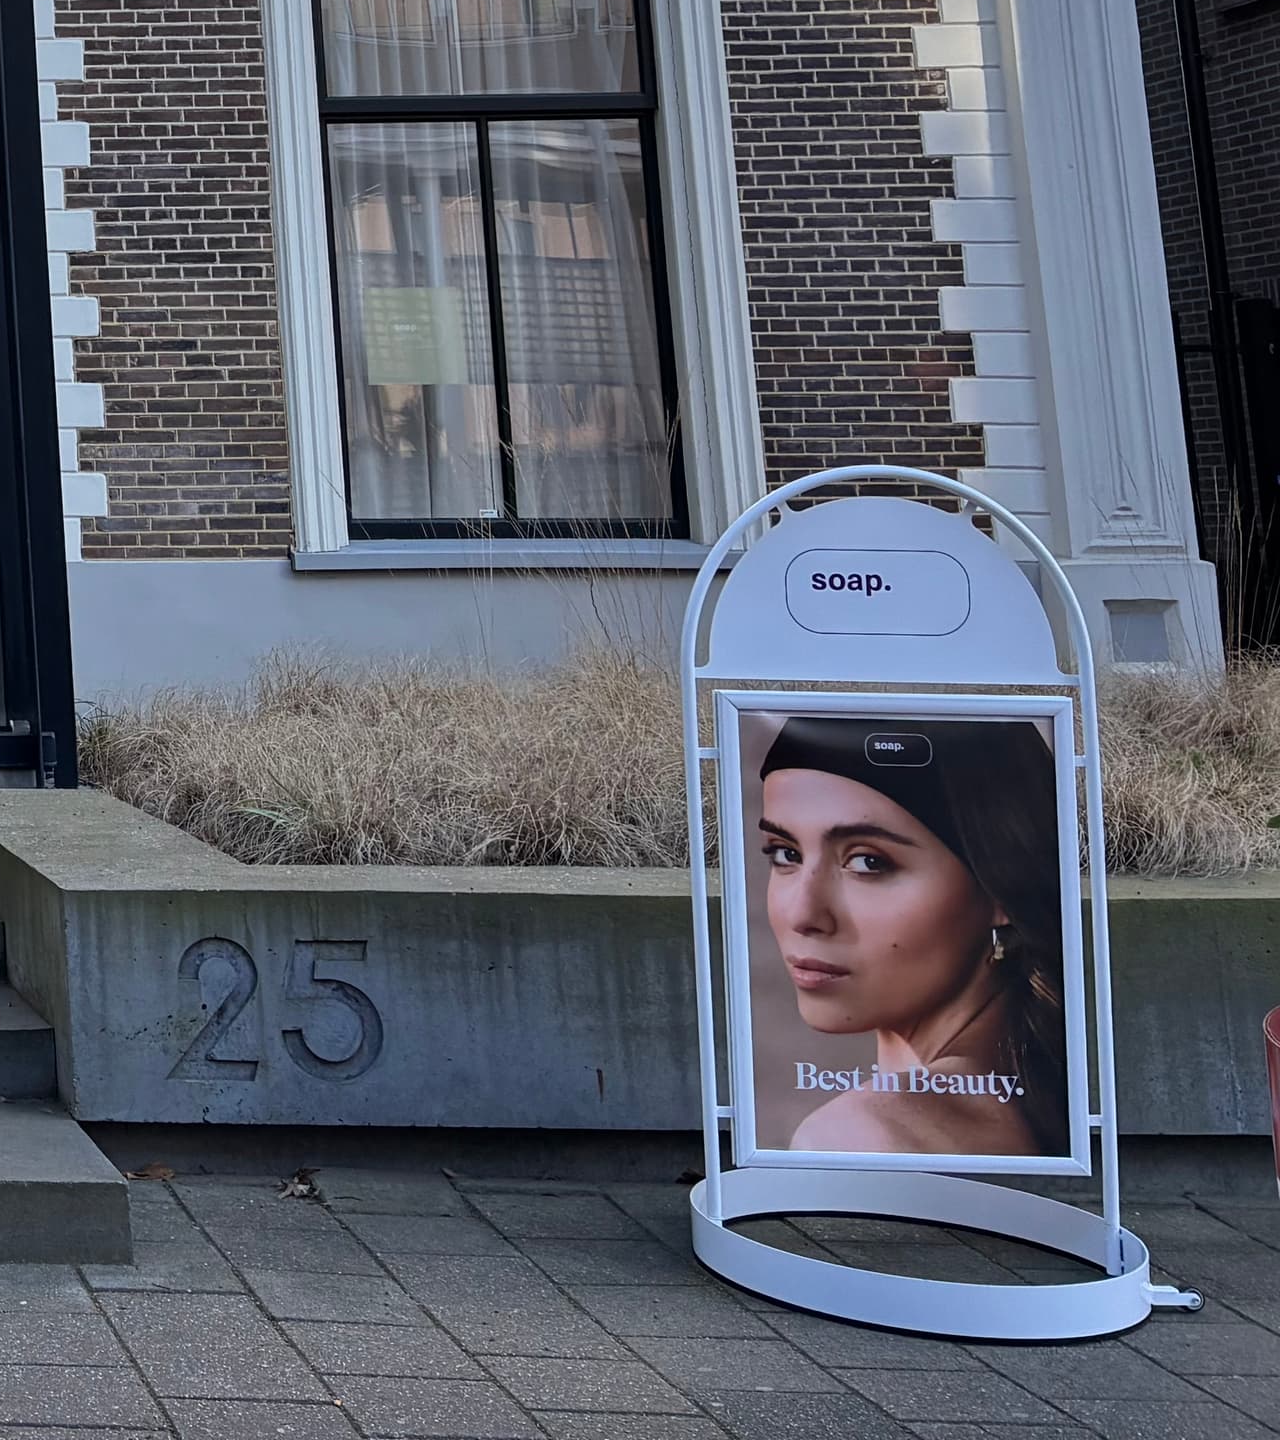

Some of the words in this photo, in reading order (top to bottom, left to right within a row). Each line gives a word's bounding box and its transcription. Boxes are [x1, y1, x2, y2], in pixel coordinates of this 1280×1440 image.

[811, 572, 892, 597] soap.
[874, 742, 905, 752] soap.
[166, 936, 384, 1082] 25
[793, 1062, 865, 1092] Best
[871, 1064, 901, 1093] in
[907, 1066, 1025, 1104] Beauty.
